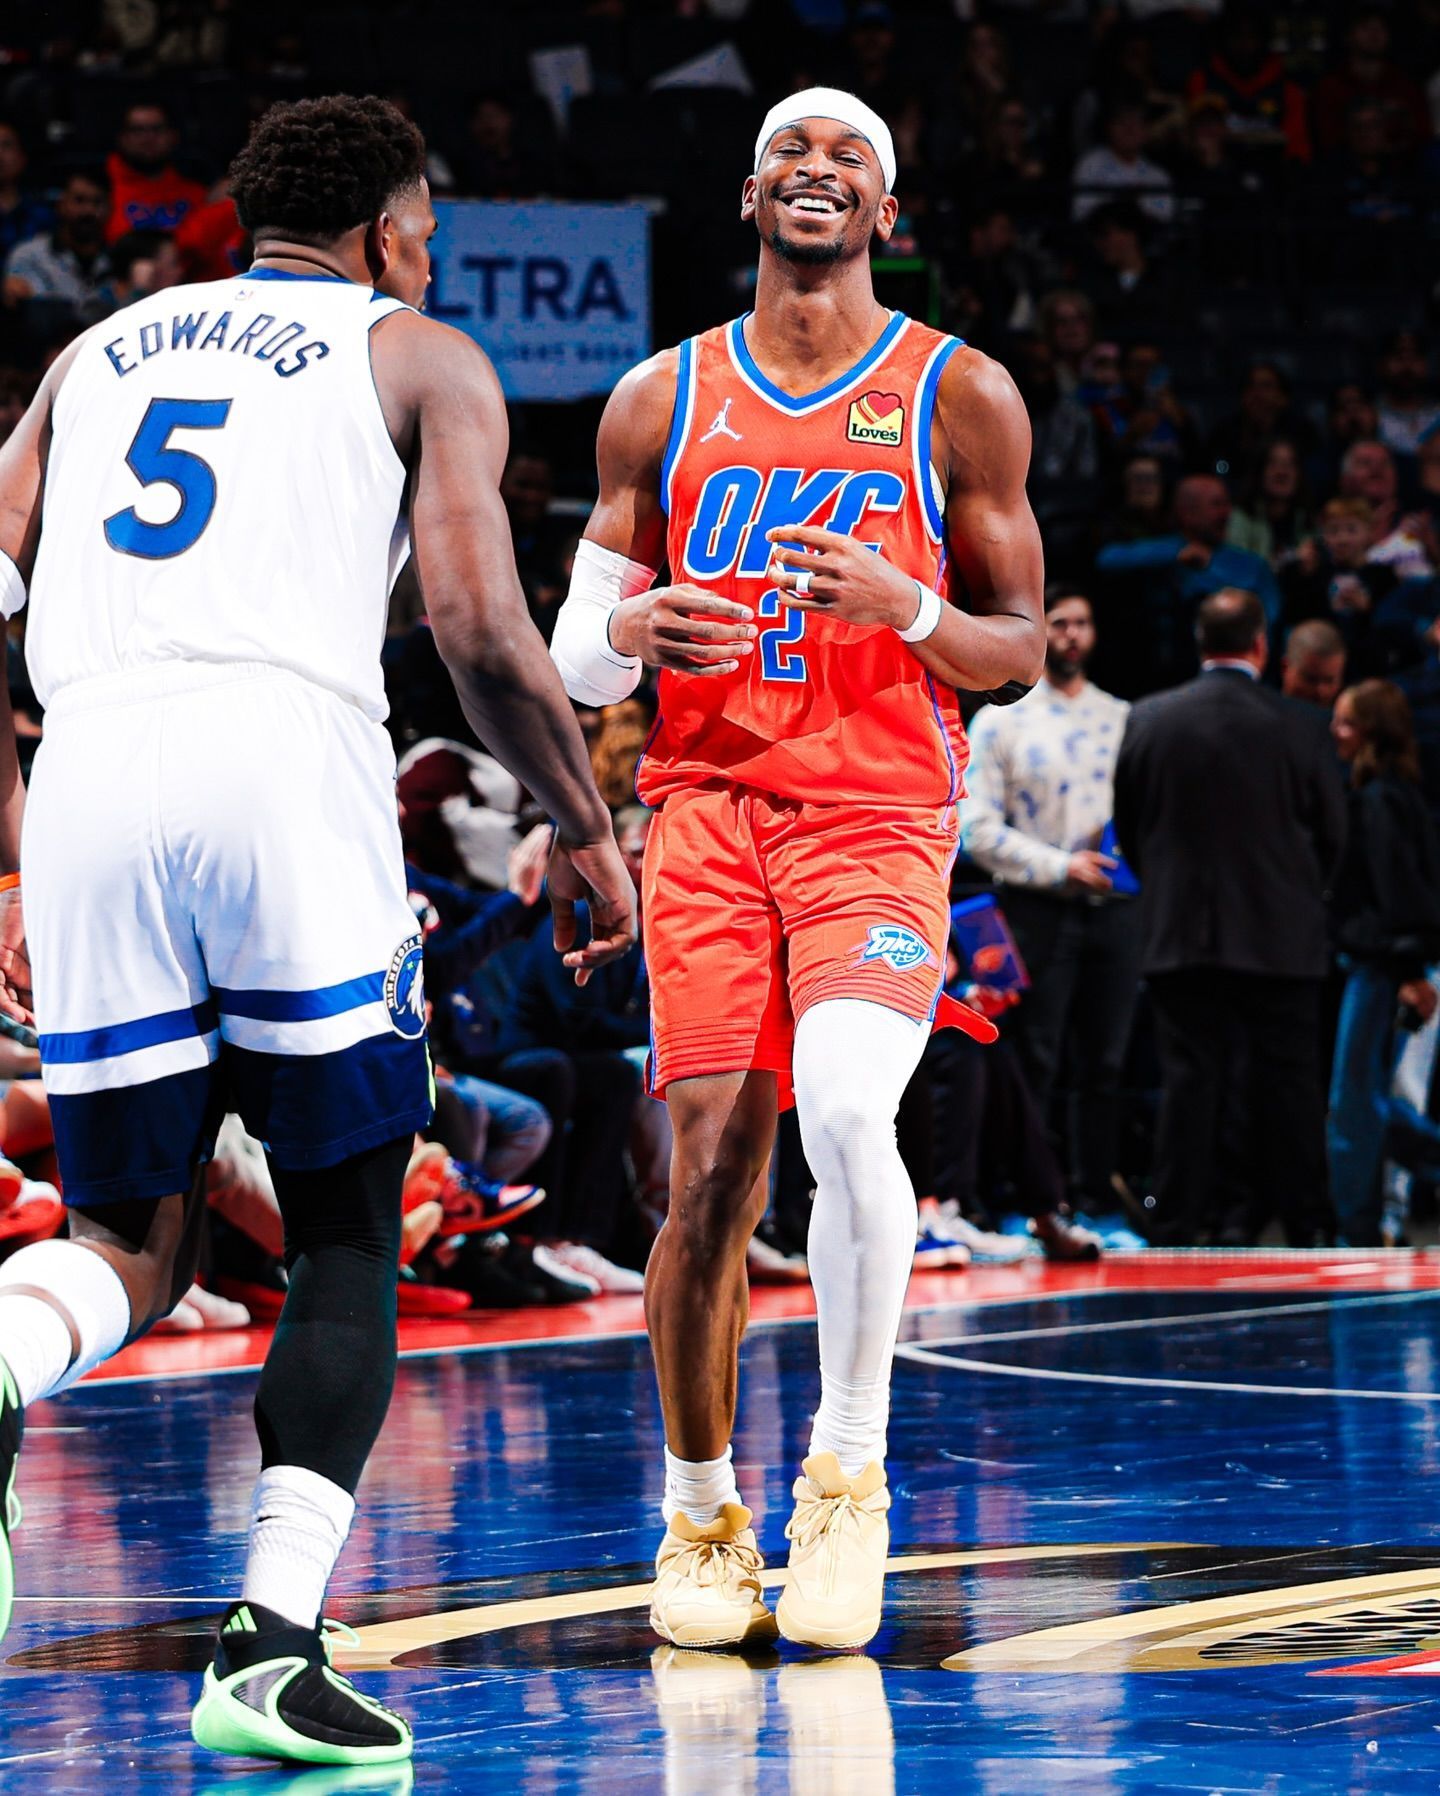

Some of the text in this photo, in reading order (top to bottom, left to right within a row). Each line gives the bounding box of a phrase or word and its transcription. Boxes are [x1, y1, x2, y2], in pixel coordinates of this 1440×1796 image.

[104, 311, 330, 378] EDWARDS
[103, 397, 234, 560] 5
[682, 465, 905, 580] OKC
[759, 588, 806, 682] 2
